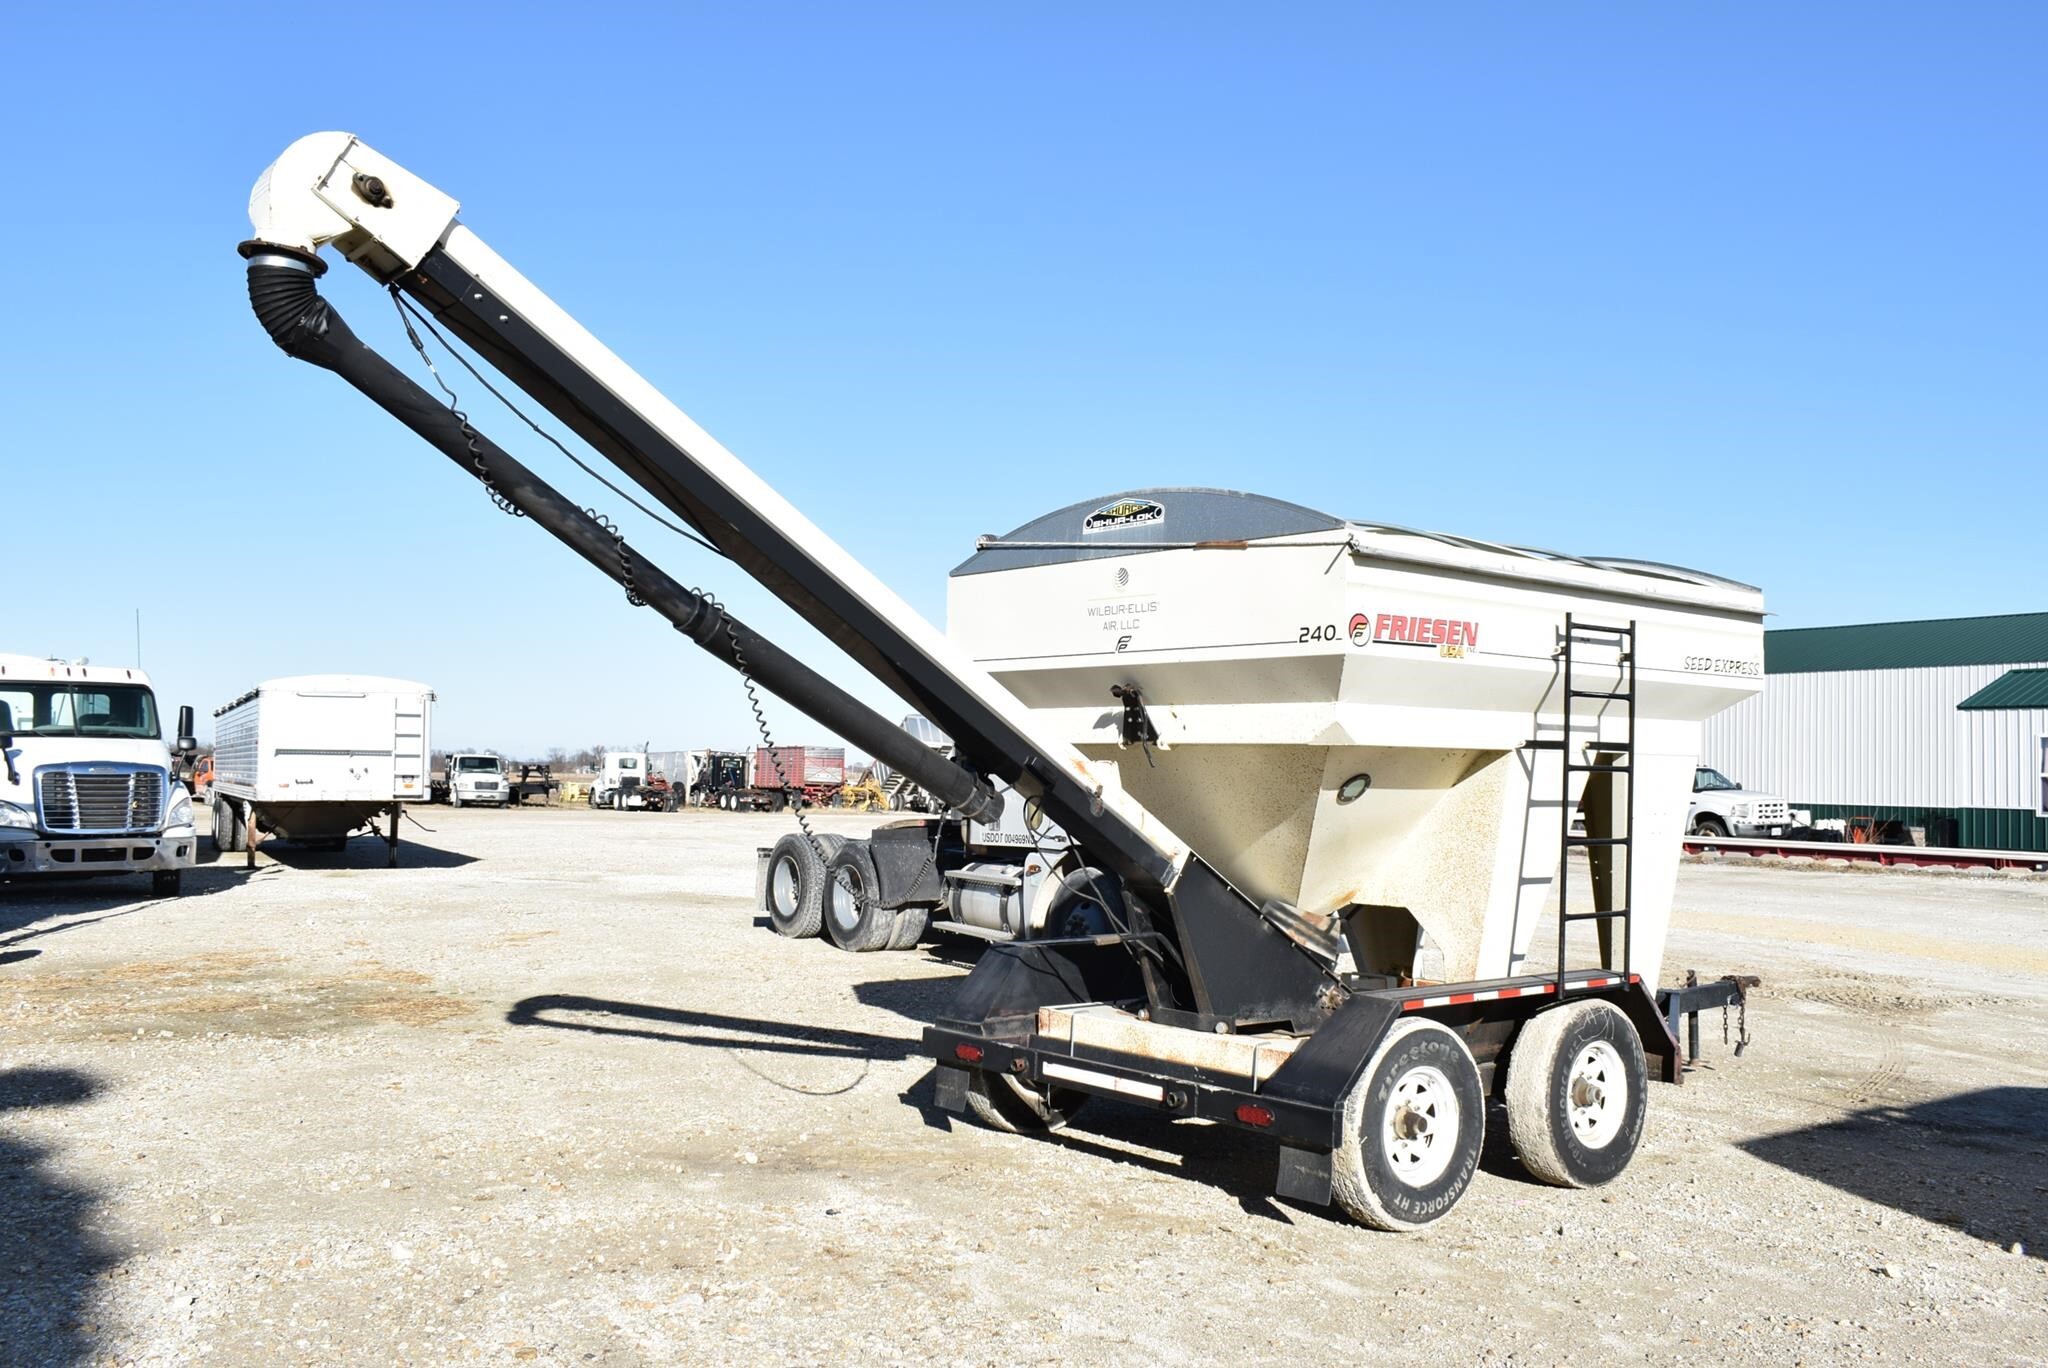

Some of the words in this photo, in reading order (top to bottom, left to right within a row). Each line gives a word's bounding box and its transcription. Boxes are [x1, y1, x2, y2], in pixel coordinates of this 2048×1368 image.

[1093, 512, 1153, 527] SHUR-LOK
[1087, 601, 1157, 616] WILBUR-ELLIS
[1103, 620, 1118, 631] AIR,
[1120, 619, 1140, 629] LLC
[1299, 624, 1336, 643] 240
[1373, 614, 1479, 646] FRIESEN
[1684, 656, 1712, 671] SEED
[1714, 659, 1760, 675] EXPRESS
[982, 832, 1004, 844] USDOT
[1413, 1148, 1477, 1214] TRANSFORCE
[1393, 1193, 1410, 1210] HT
